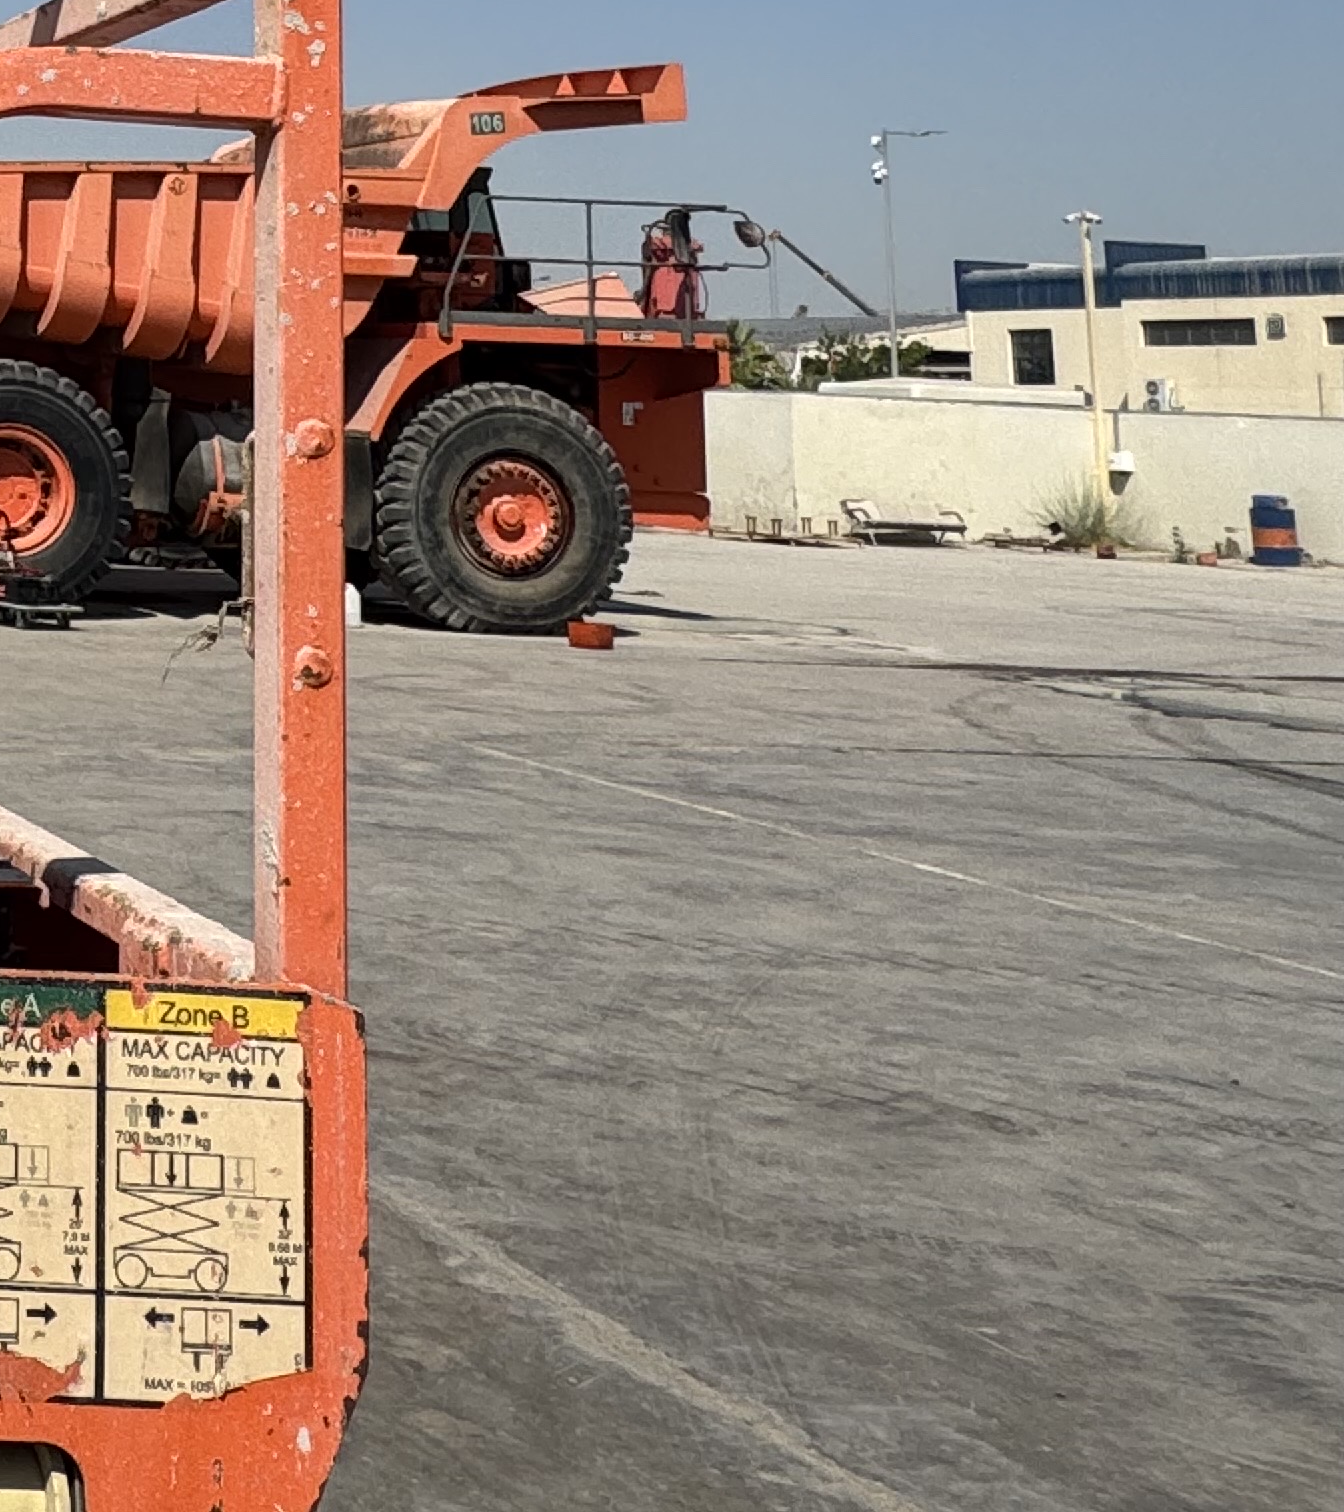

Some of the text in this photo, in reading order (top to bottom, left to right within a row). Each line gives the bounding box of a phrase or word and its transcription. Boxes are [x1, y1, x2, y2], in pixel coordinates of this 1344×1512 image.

[472, 114, 504, 134] 106
[25, 992, 42, 1020] A
[158, 1000, 250, 1029] Zone B
[121, 1038, 285, 1067] MAX CAPACITY
[126, 1063, 149, 1077] 700
[115, 1129, 212, 1152] 700 lbs/317 kg
[144, 1377, 174, 1391] MAX
